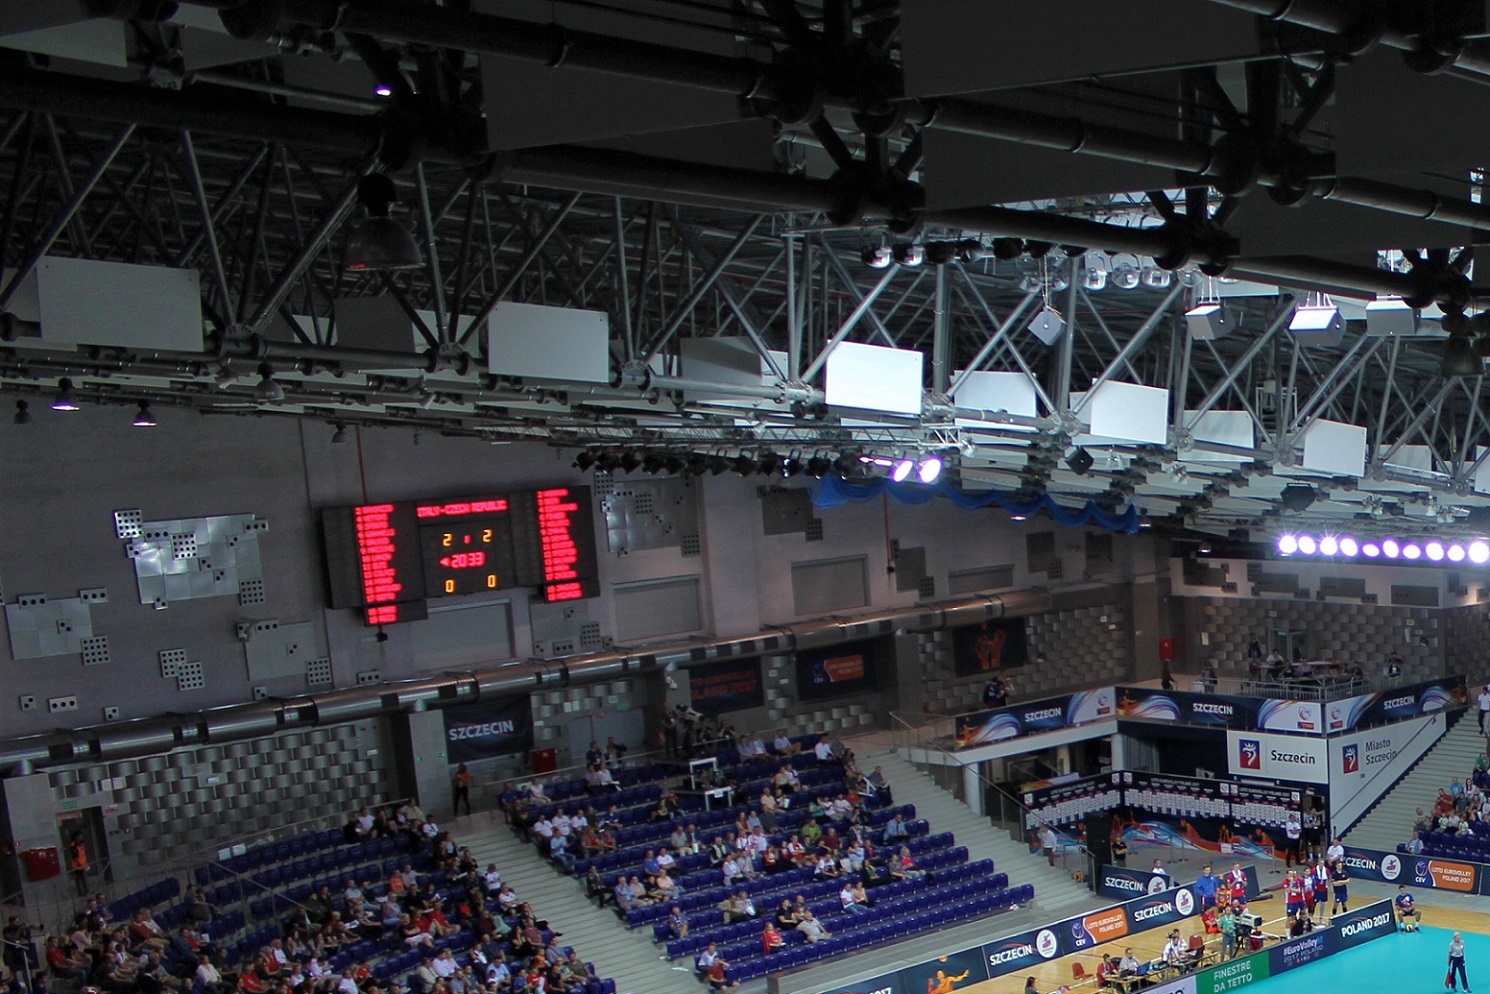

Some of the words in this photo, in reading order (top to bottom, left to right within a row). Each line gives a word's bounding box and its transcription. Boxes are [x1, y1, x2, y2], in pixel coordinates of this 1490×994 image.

[471, 499, 508, 513] REPUBLIC
[442, 533, 452, 547] 2
[482, 529, 492, 543] 2
[445, 579, 455, 593] 0
[487, 574, 497, 588] 0
[1193, 703, 1233, 715] SZCZECIN
[1384, 695, 1415, 710] SZCZECIN
[1024, 707, 1062, 723] SZCZECIN
[449, 720, 514, 741] SZCZECIN
[1365, 738, 1391, 752] Miasto
[1271, 750, 1316, 765] Szczecin
[1365, 750, 1398, 765] Szczecin
[1415, 875, 1426, 883] CEV
[1442, 874, 1457, 882] POLAND
[1458, 876, 1471, 884] 2017
[1446, 867, 1472, 877] EUROVOLLEY
[1105, 877, 1144, 891] SZCZECIN
[1134, 902, 1172, 922] SZCZECIN
[1098, 914, 1123, 927] EUROVOLLEY
[1099, 923, 1114, 933] POLAND
[1341, 919, 1373, 938] POLAND
[1373, 912, 1391, 926] 2017
[1075, 938, 1086, 947] CEV
[990, 944, 1033, 966] SZCZECIN
[1284, 951, 1299, 963] 2017
[1300, 945, 1324, 957] POLAND
[1214, 960, 1251, 980] FINESTRE
[1214, 982, 1226, 994] DA
[1227, 973, 1252, 989] TETTO
